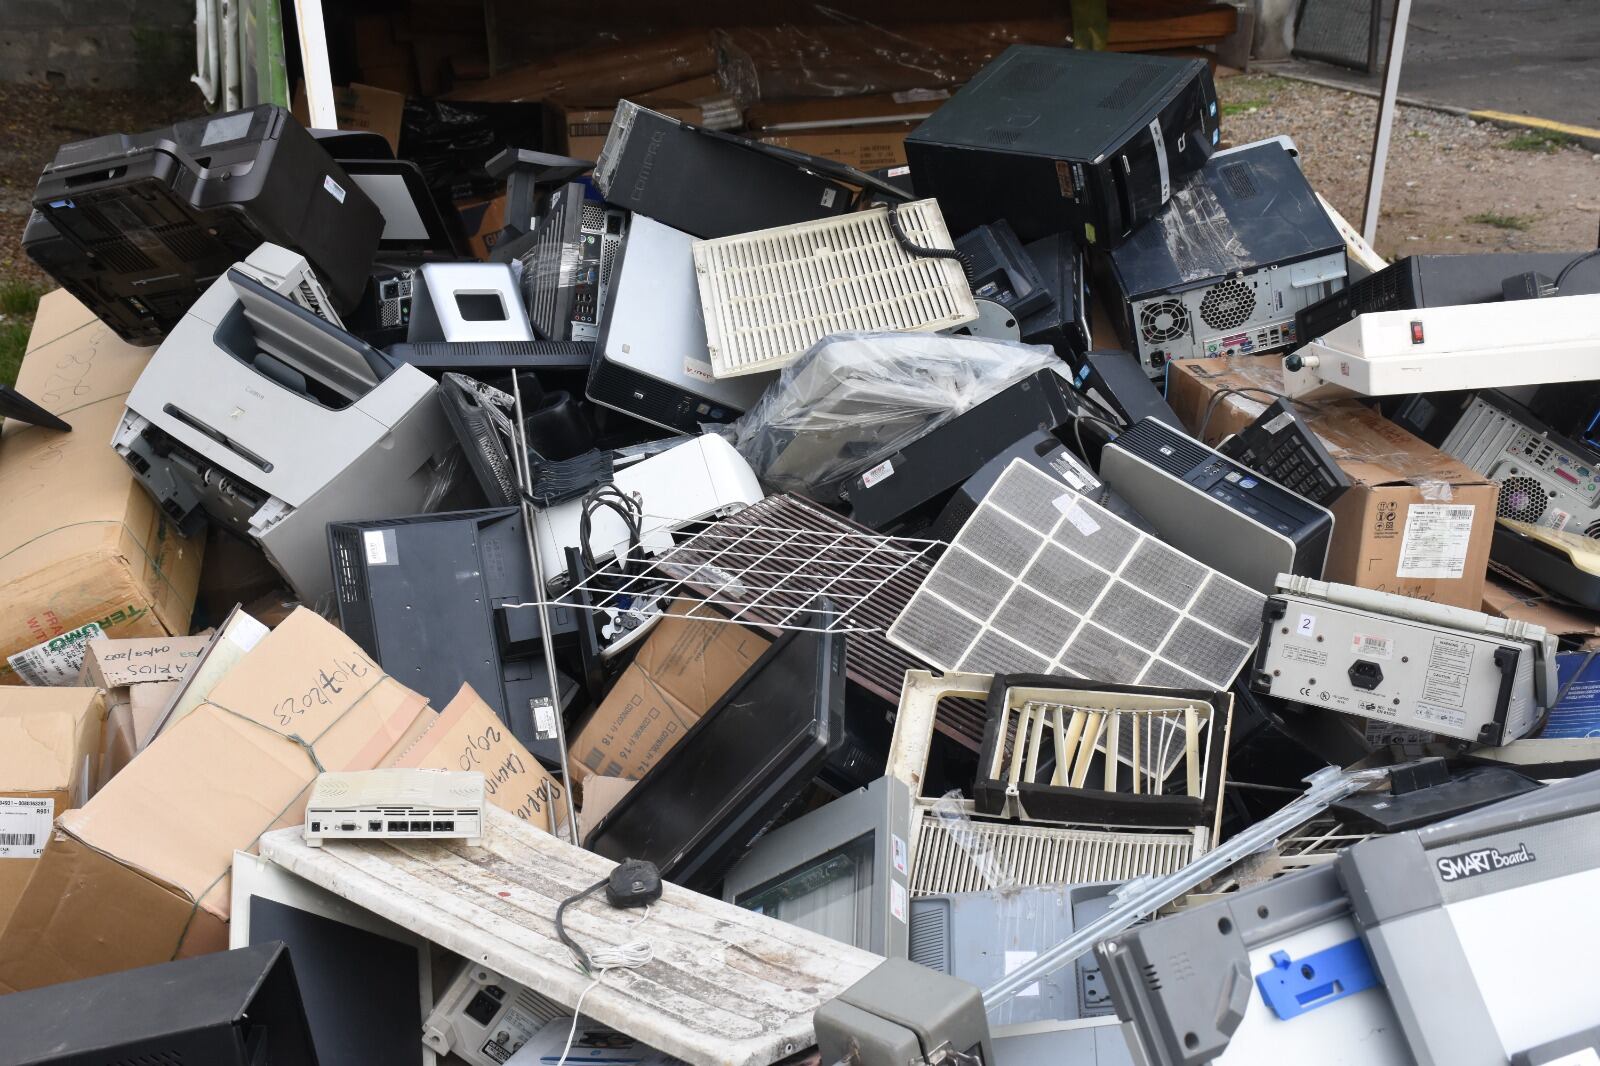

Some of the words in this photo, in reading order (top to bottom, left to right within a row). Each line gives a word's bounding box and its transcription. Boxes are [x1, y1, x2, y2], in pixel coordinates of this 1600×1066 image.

[43, 610, 64, 635] FRA
[49, 605, 143, 652] TERUMO
[1302, 618, 1311, 629] 2
[602, 733, 614, 747] 18
[619, 747, 631, 760] 16
[636, 760, 649, 773] 14
[1438, 850, 1491, 881] SMART
[1491, 844, 1529, 869] Board
